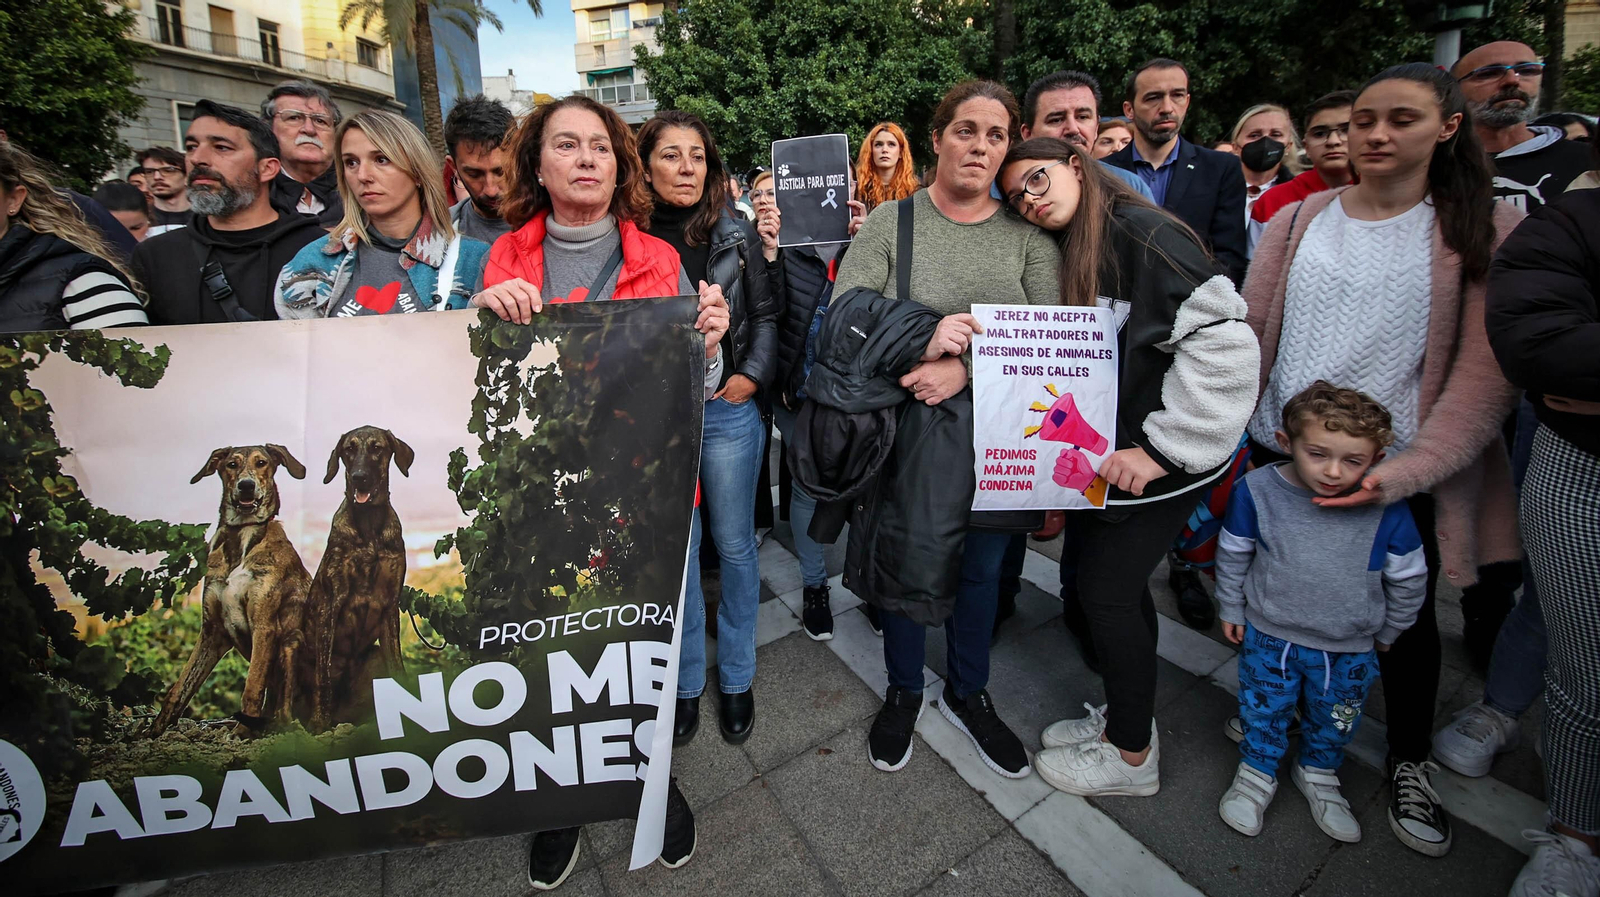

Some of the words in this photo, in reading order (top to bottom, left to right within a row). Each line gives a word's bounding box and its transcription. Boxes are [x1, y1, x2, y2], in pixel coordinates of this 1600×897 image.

[778, 178, 805, 190] JUSTICIA
[807, 175, 825, 189] PARA
[336, 299, 363, 318] ME
[994, 310, 1030, 321] JEREZ
[1034, 311, 1049, 322] NO
[1052, 312, 1097, 323] ACEPTA
[986, 328, 1089, 341] MALTRATADORES
[1092, 331, 1104, 342] NI
[978, 346, 1034, 358] ASESINOS
[1037, 347, 1052, 358] DE
[1055, 348, 1113, 360] ANIMALES
[1003, 364, 1018, 376] EN
[1021, 365, 1044, 376] SUS
[1047, 366, 1090, 377] CALLES
[985, 448, 1037, 461] PEDIMOS
[983, 462, 1035, 476] MÁXIMA
[979, 479, 1033, 491] CONDENA
[479, 603, 676, 650] PROTECTORA
[372, 661, 528, 741] NO
[546, 640, 672, 715] ME
[0, 761, 21, 810] ANDONES
